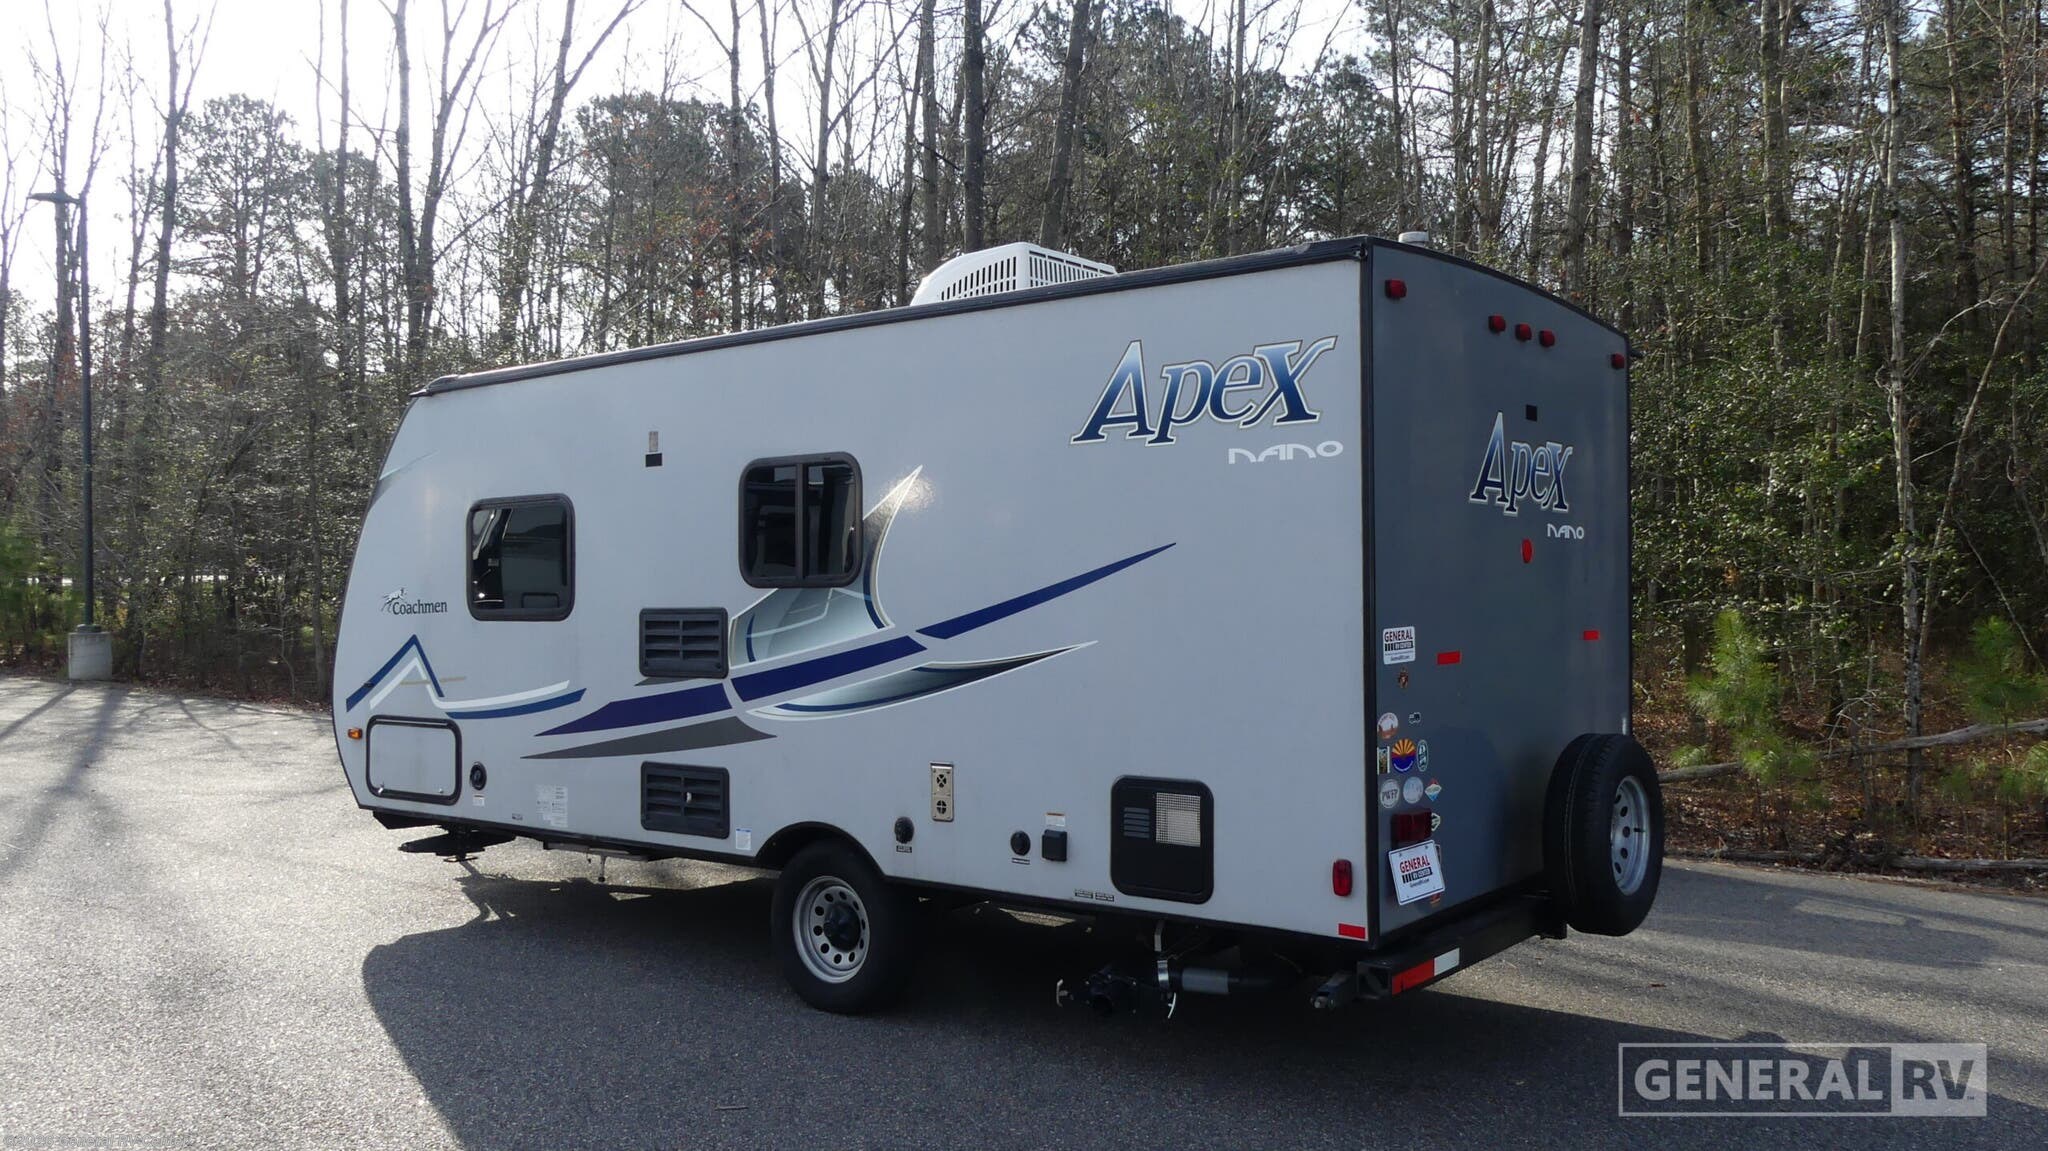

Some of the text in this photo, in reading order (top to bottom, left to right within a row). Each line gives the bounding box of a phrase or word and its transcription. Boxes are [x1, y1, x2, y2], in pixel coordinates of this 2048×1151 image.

[392, 599, 448, 615] Coachmen
[1384, 628, 1413, 642] GENERAL
[1399, 855, 1431, 873] GENERAL
